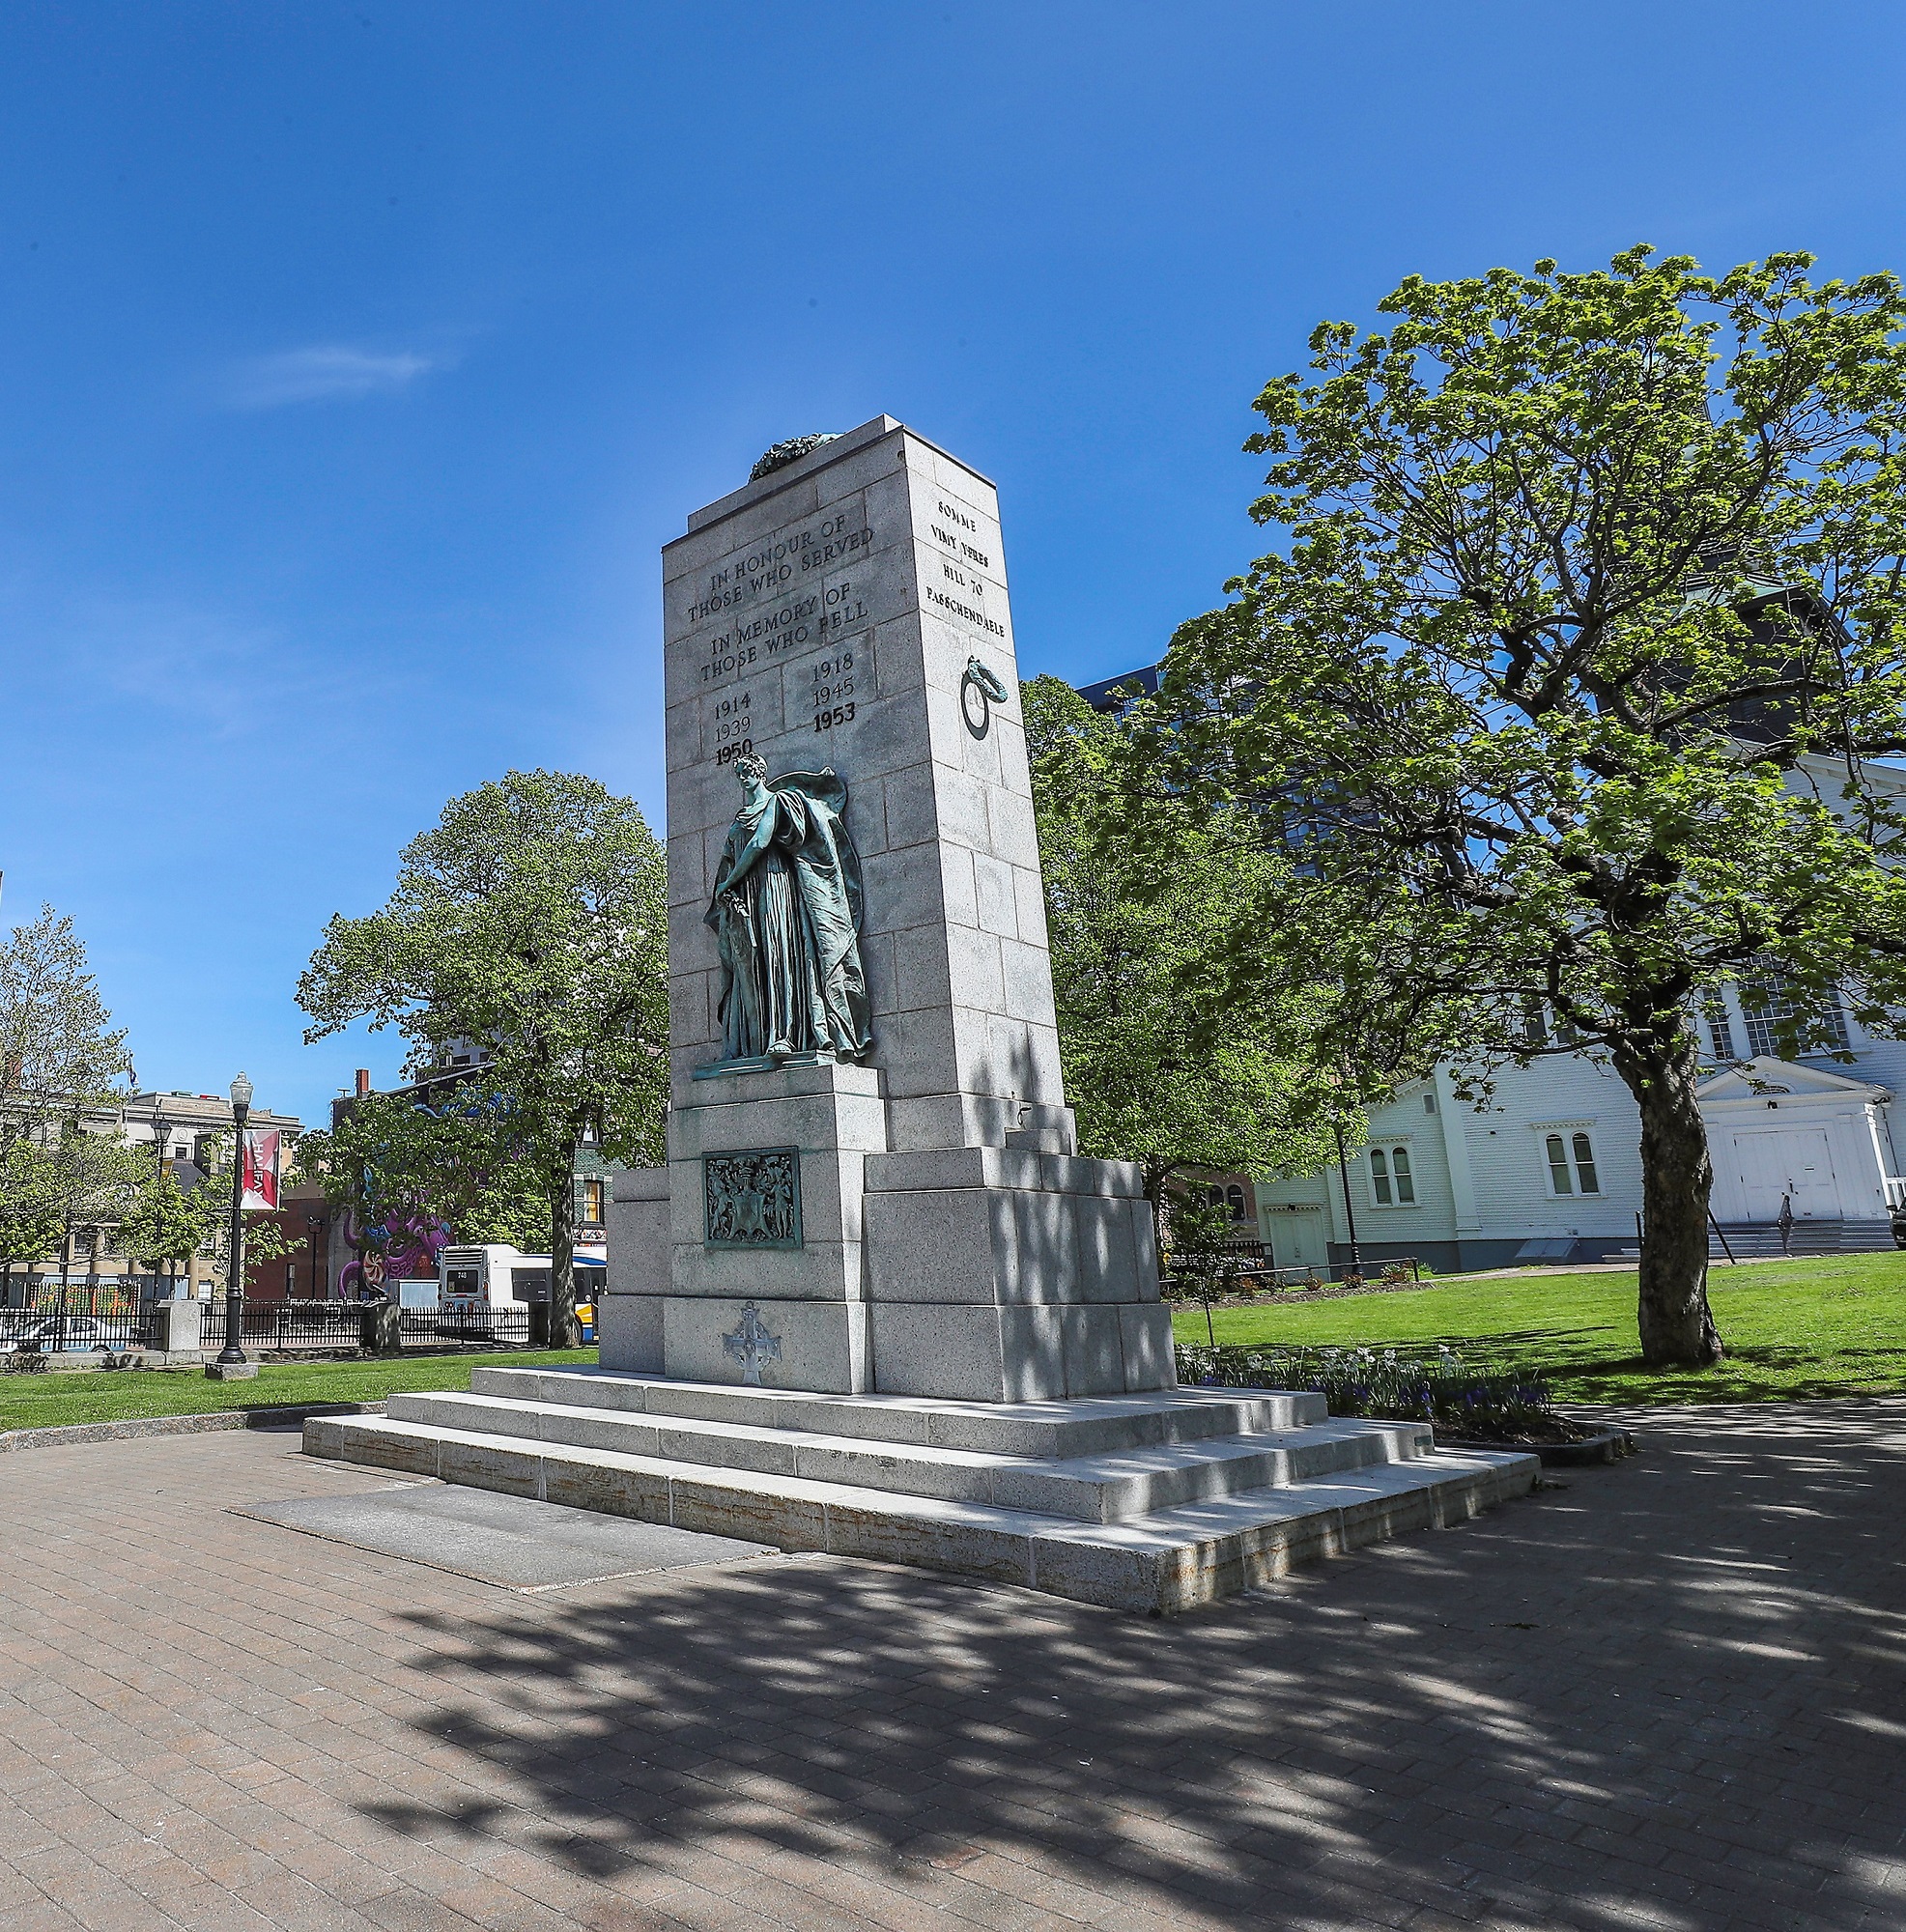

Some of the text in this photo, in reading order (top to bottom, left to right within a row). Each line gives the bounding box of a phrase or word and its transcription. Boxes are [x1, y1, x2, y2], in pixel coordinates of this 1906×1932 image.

[938, 500, 977, 532] SOMME
[710, 514, 845, 591] IN HONOUR OF
[930, 524, 989, 568] VIMY YPRES
[688, 527, 874, 623] THOSE WHO SERVED
[943, 563, 966, 587] HILL
[711, 582, 851, 656] IN MEMORY OF
[926, 585, 1006, 638] PASSCHENDAELE
[700, 601, 868, 682] THOSE WHO FELL
[812, 652, 854, 683] 1918
[715, 691, 752, 721] 1914
[812, 675, 855, 707] 1945
[715, 716, 752, 743] 1939
[813, 701, 856, 733] 1953
[716, 738, 753, 766] 1950
[253, 1143, 265, 1199] HALIFAX
